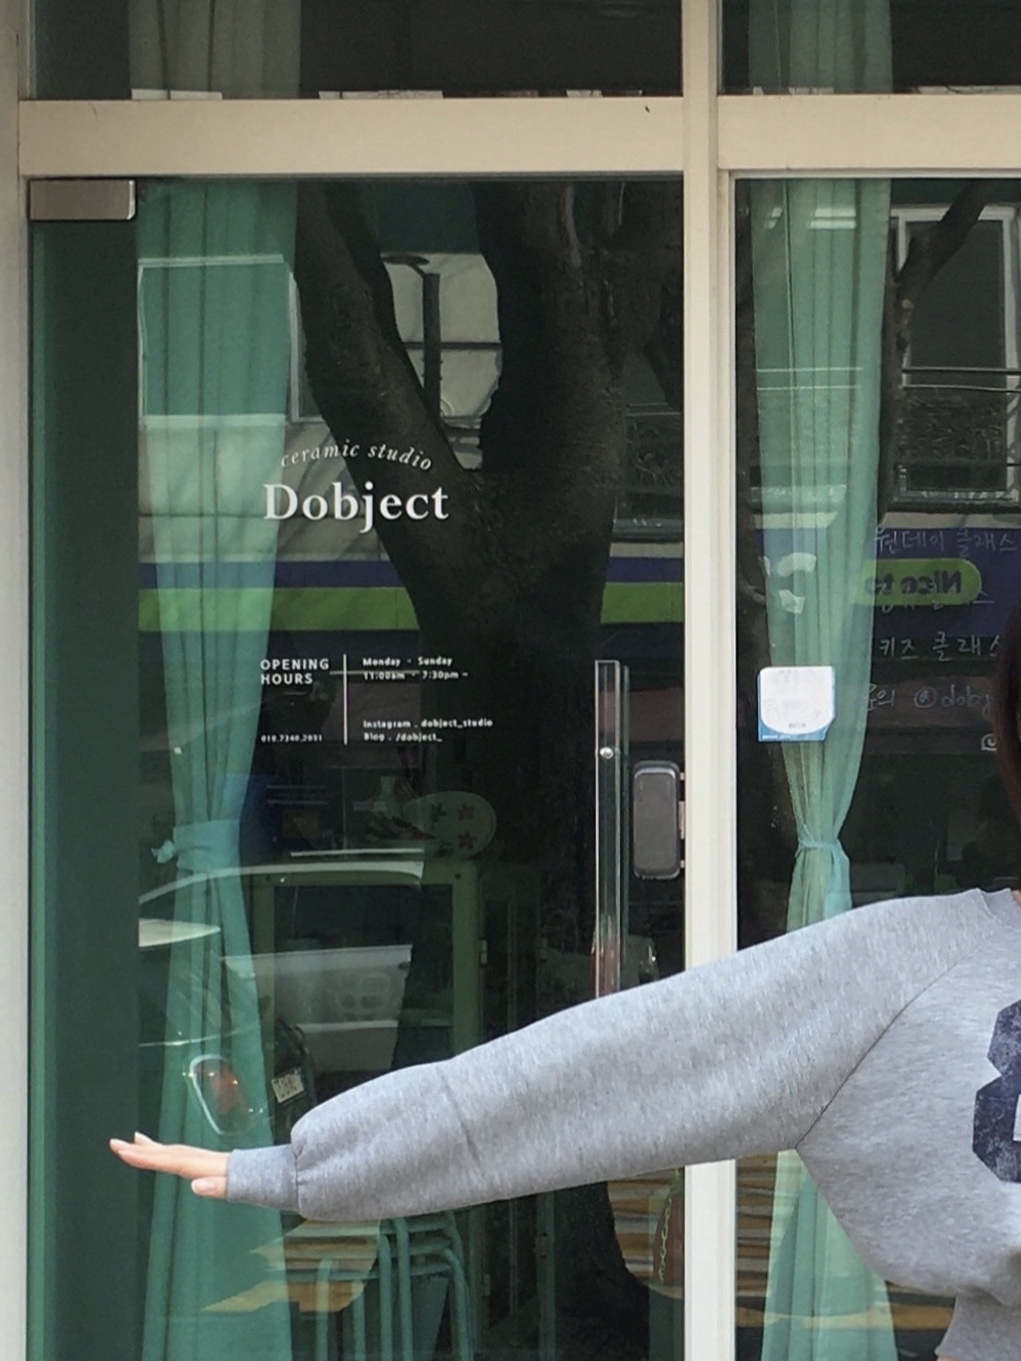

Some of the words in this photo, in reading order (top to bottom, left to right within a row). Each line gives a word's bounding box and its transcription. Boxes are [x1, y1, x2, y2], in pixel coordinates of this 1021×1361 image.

[281, 438, 360, 468] ceramic
[367, 443, 432, 471] studio
[263, 480, 449, 534] Dobject
[879, 635, 919, 660] 키즈
[259, 658, 330, 671] OPENING
[362, 657, 402, 667] Monday
[417, 655, 453, 667] Sunday
[260, 672, 314, 686] HOURS
